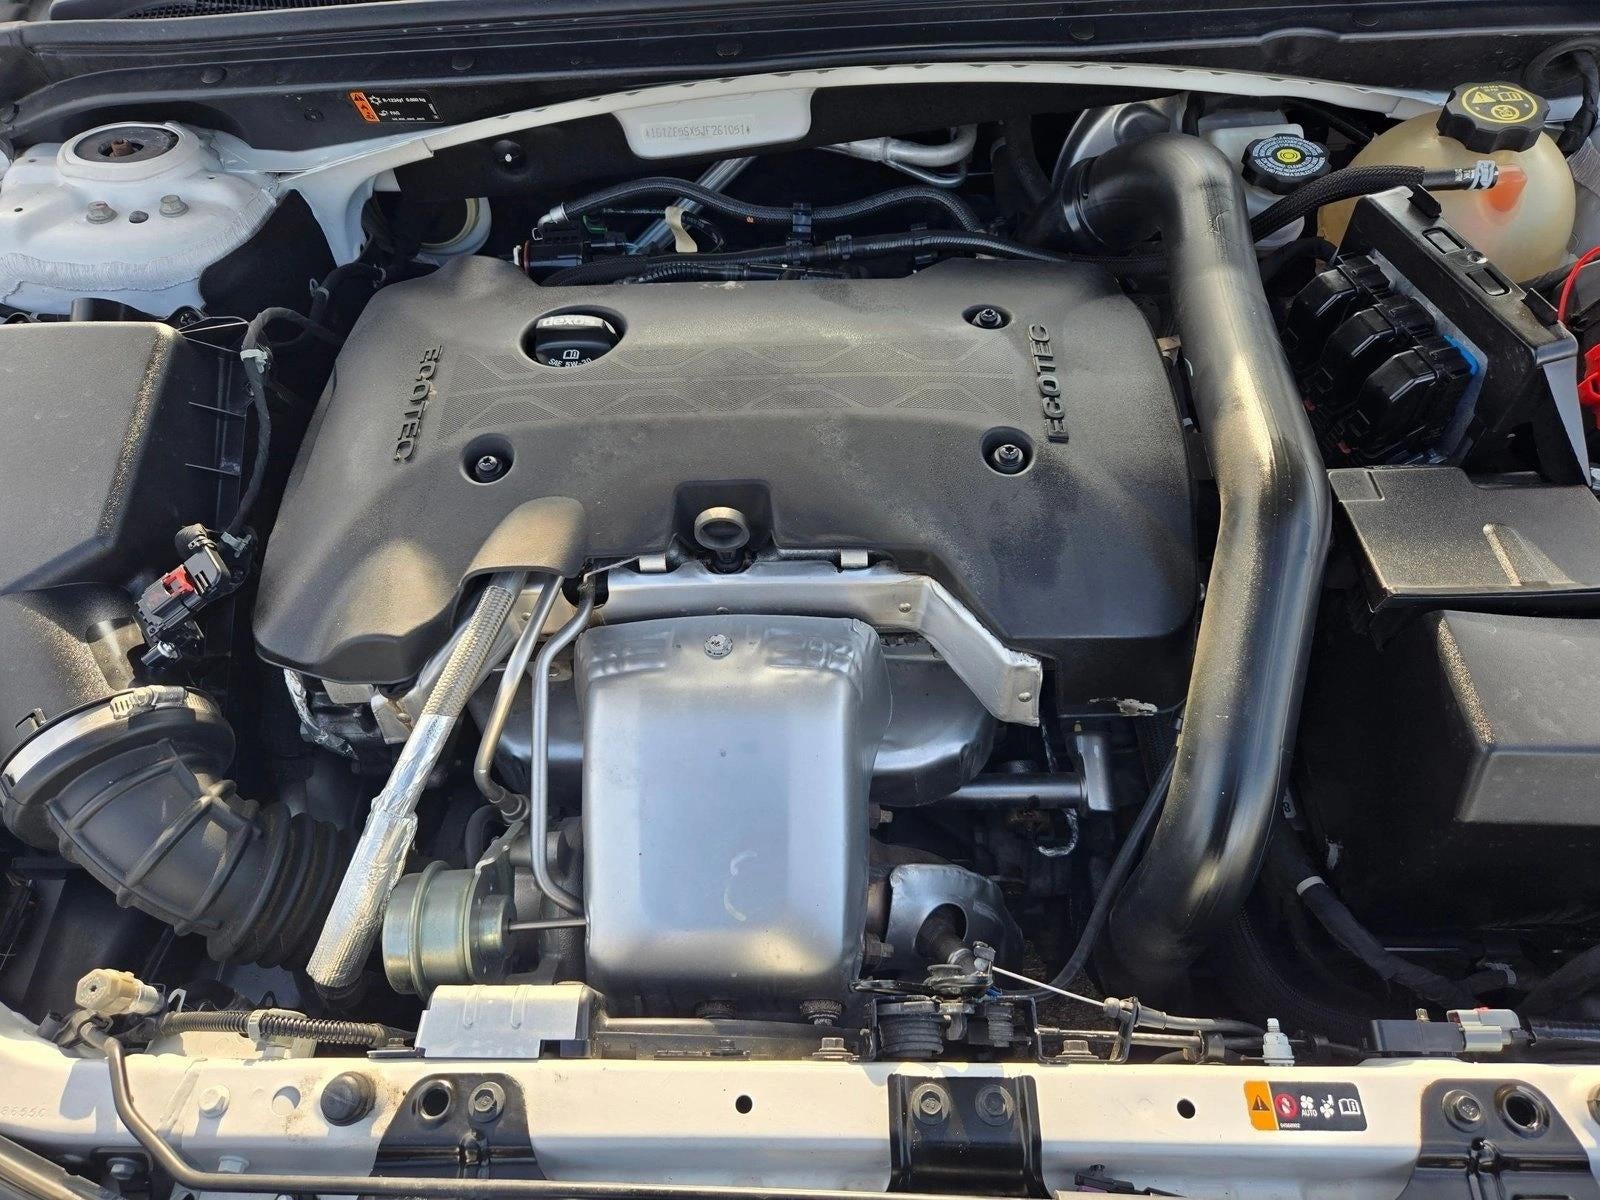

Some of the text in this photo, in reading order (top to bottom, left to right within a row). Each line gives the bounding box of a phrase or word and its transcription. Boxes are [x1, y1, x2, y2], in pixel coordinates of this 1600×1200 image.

[394, 345, 444, 461] ECOTEC
[1028, 324, 1069, 443] ECOTEC
[1301, 1109, 1318, 1117] AUTO
